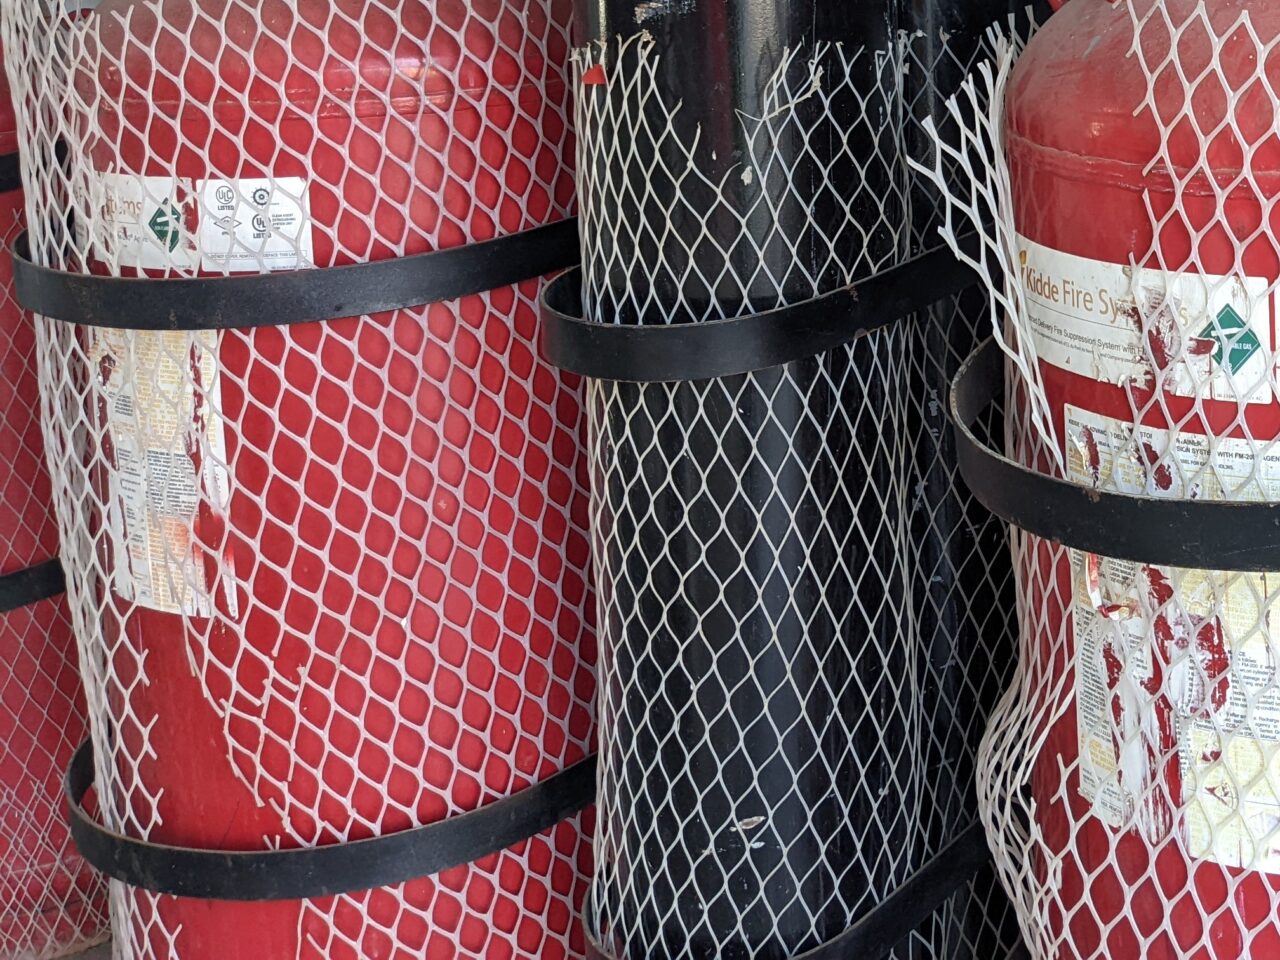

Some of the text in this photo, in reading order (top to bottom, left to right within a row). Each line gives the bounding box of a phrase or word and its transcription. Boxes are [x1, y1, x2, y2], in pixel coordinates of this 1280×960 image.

[218, 188, 232, 201] ULC
[1026, 267, 1059, 303] Kidde
[1063, 279, 1094, 312] Fire
[1053, 325, 1063, 336] Fire
[1063, 328, 1096, 345] Suppression
[1097, 338, 1121, 352] System
[1122, 343, 1136, 354] with
[1242, 342, 1252, 350] GAS
